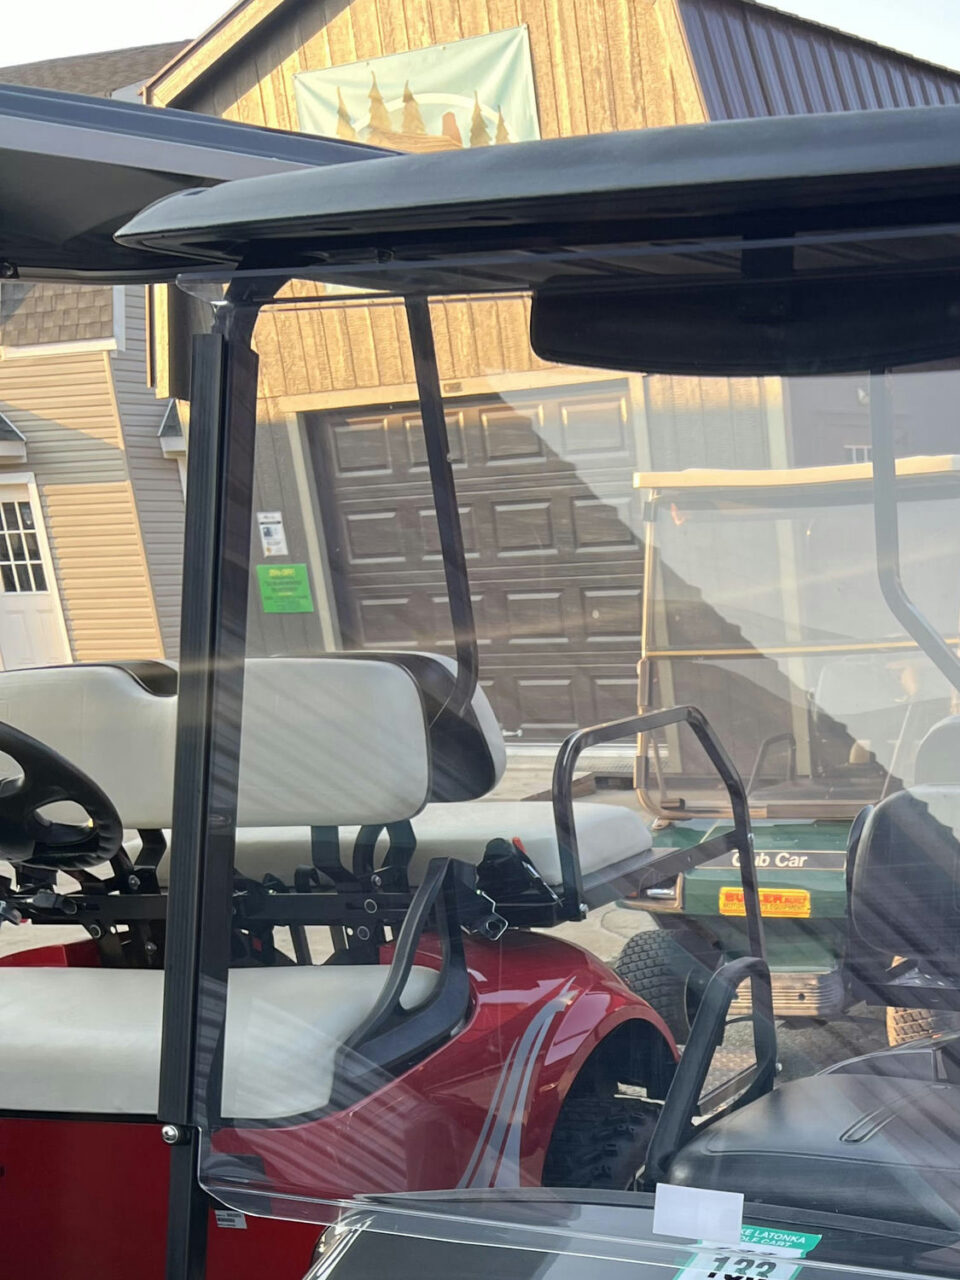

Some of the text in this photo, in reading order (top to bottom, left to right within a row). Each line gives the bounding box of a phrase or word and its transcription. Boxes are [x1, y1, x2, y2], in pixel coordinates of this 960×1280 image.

[775, 852, 808, 867] Car
[755, 1231, 806, 1244] LATONKA
[761, 1239, 793, 1249] CART
